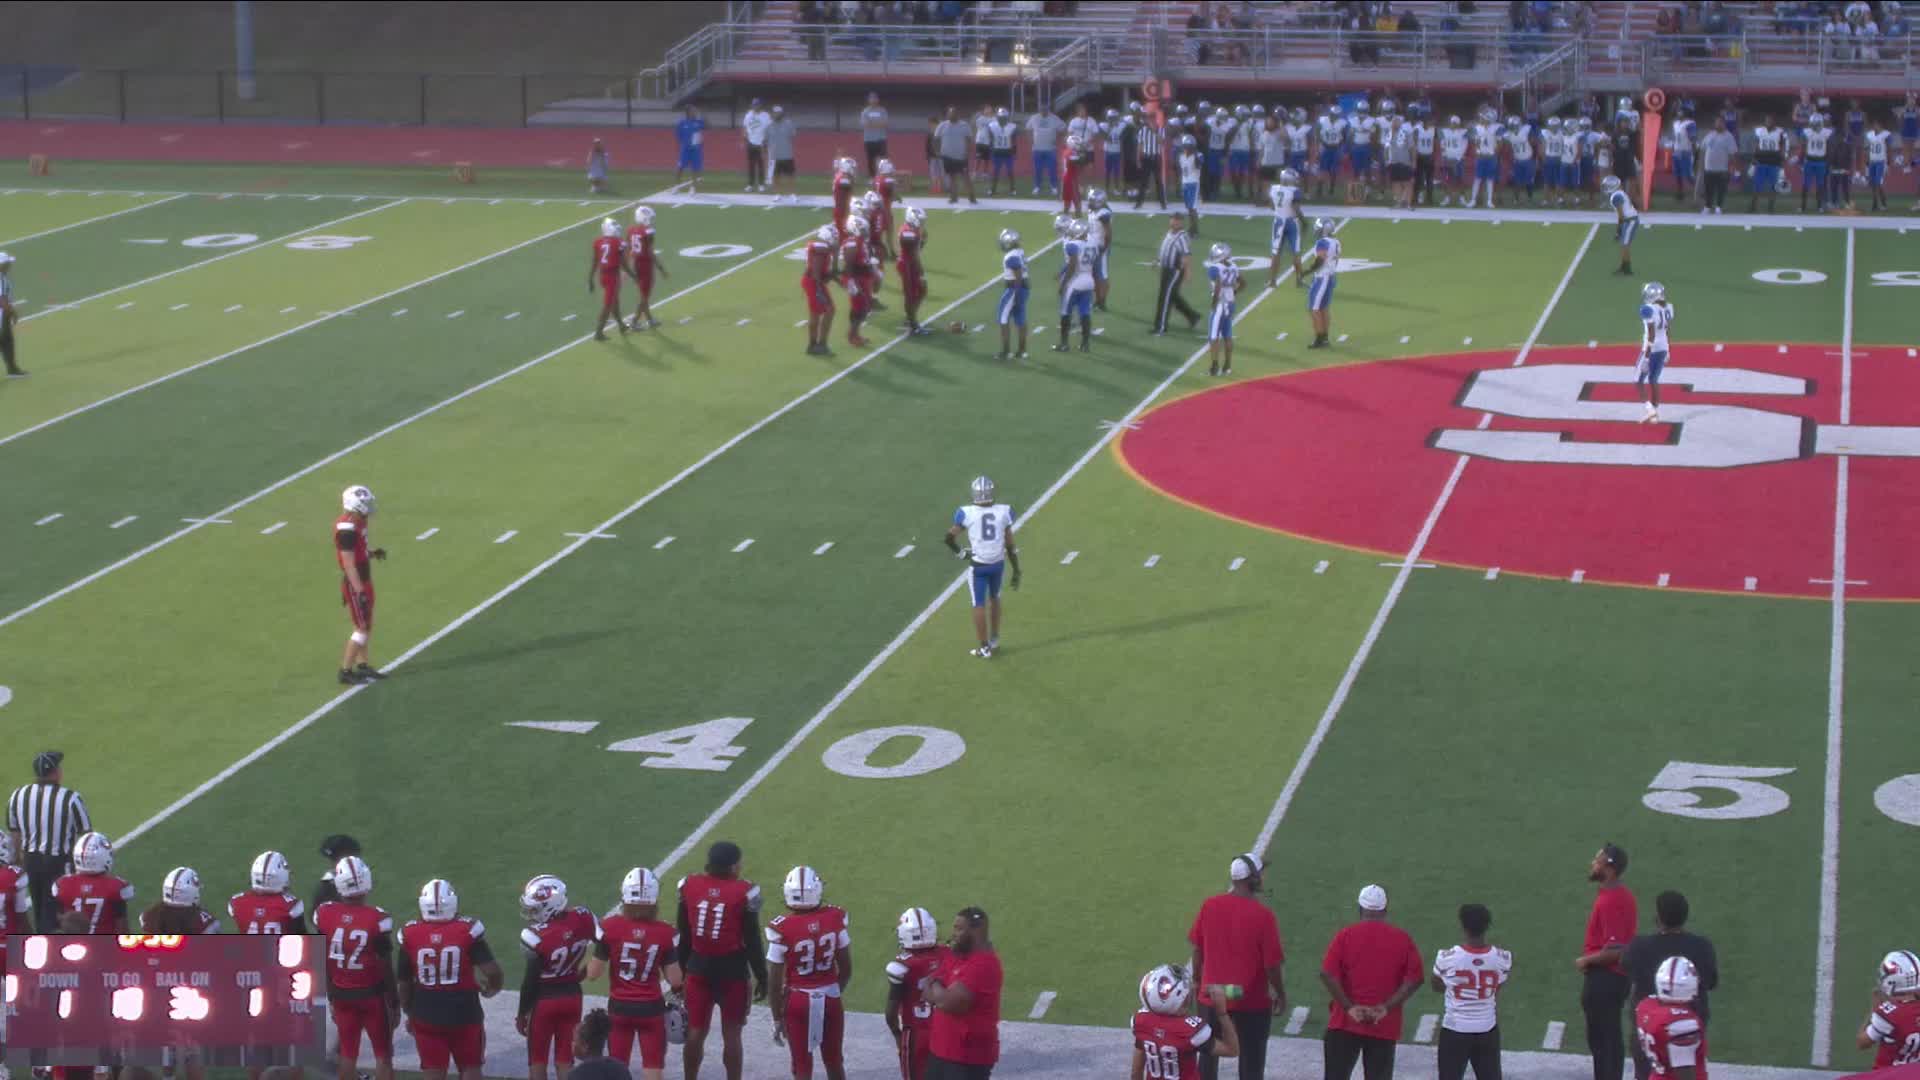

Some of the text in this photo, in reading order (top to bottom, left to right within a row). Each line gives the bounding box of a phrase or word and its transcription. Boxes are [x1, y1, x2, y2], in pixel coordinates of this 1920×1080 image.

[981, 513, 996, 541] 6
[695, 900, 725, 940] 11
[329, 928, 369, 970] 42
[417, 945, 461, 986] 60
[619, 942, 660, 982] 51
[793, 932, 838, 976] 33
[1455, 969, 1499, 1000] 28
